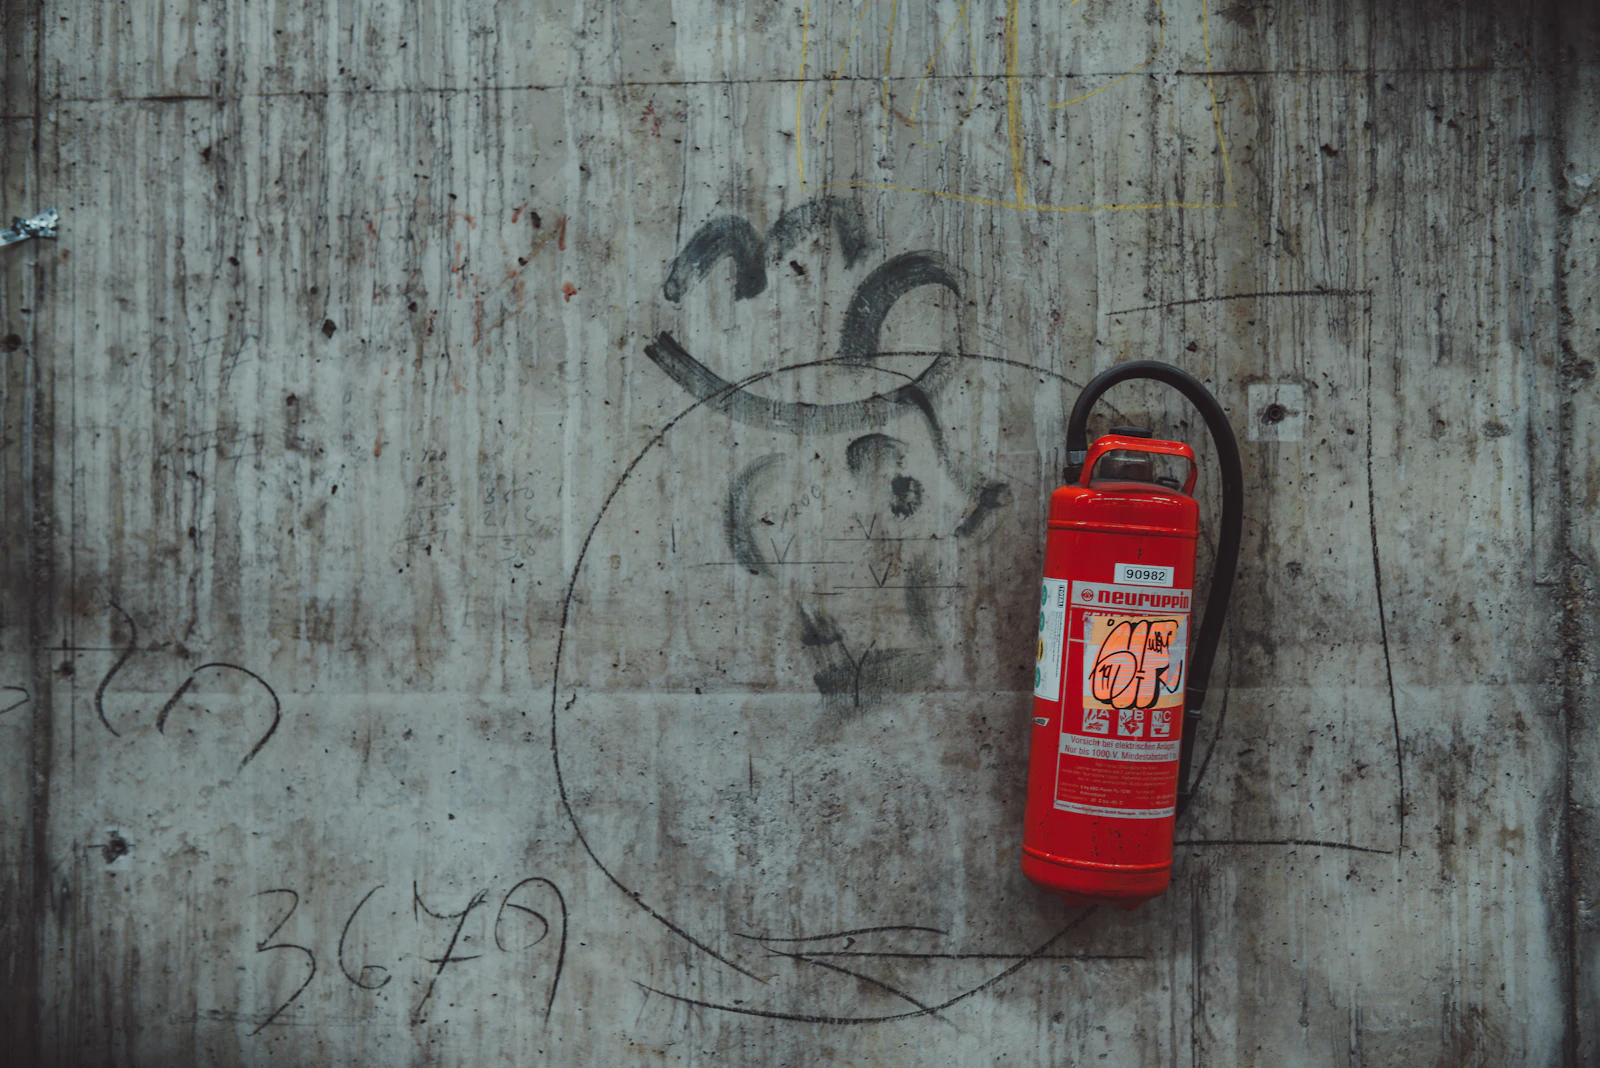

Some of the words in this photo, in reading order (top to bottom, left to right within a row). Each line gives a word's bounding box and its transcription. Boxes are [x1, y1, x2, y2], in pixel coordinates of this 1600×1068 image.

[1126, 569, 1165, 581] 90982
[1097, 590, 1189, 609] neuruppin
[1098, 708, 1110, 719] A
[1134, 710, 1145, 721] B
[1163, 710, 1172, 721] C
[1070, 735, 1100, 746] Vorsicht
[1101, 739, 1113, 748] bei
[1115, 741, 1156, 751] elektrischen
[1065, 744, 1077, 753] Nur
[1079, 746, 1090, 756] bis
[1092, 748, 1110, 758] 1000
